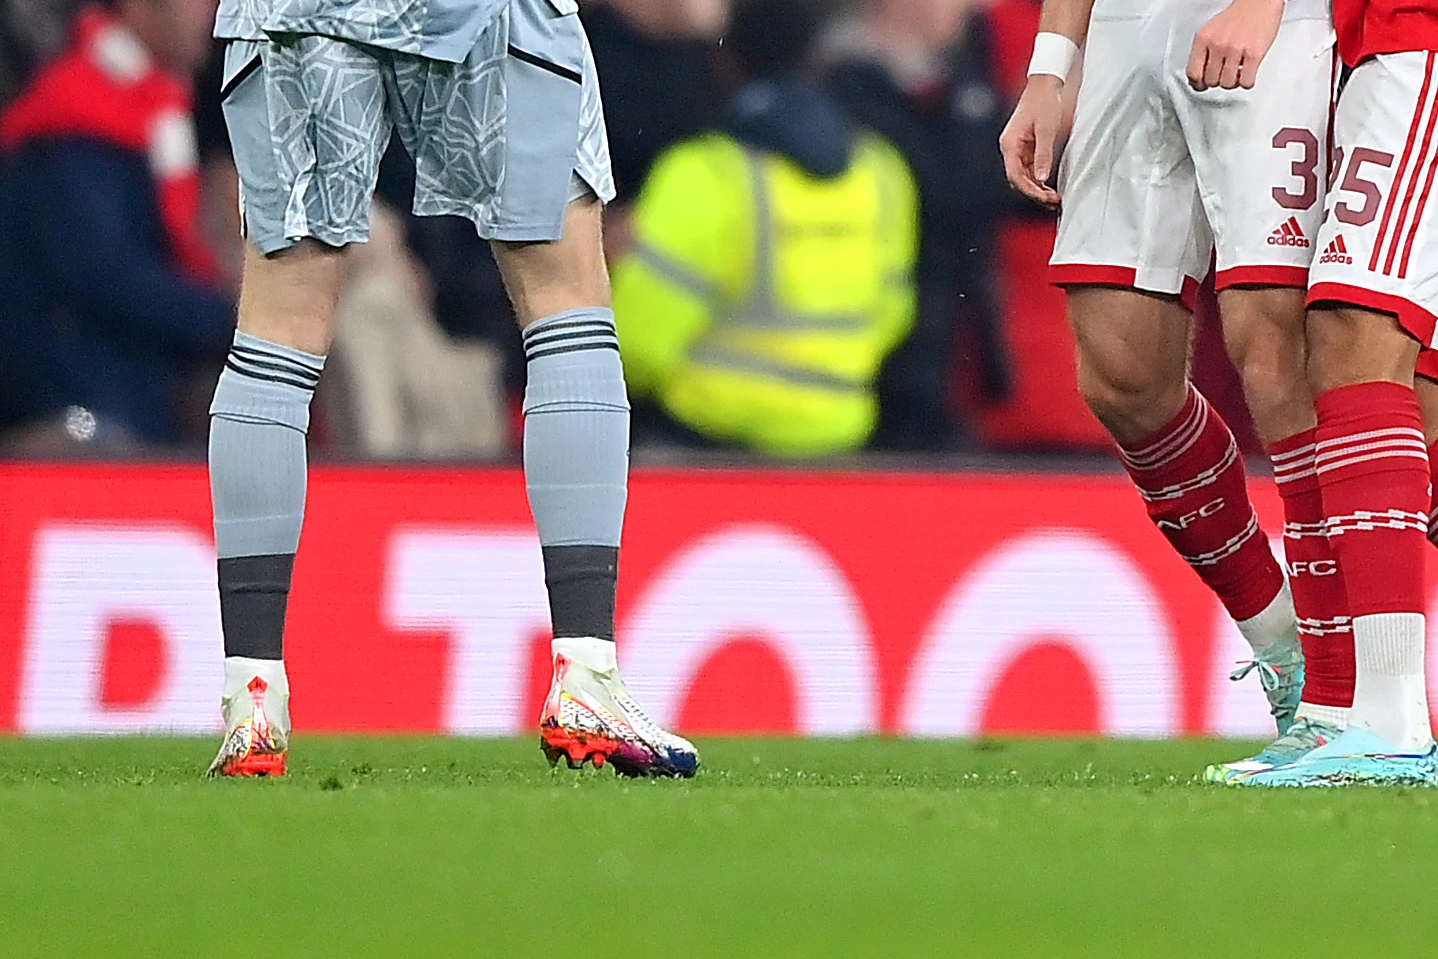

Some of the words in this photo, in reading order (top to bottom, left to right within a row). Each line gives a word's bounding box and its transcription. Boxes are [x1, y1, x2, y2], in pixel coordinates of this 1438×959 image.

[1271, 127, 1319, 211] 3
[1322, 145, 1395, 227] 5
[1267, 234, 1310, 249] adidas
[1157, 497, 1226, 531] AFC
